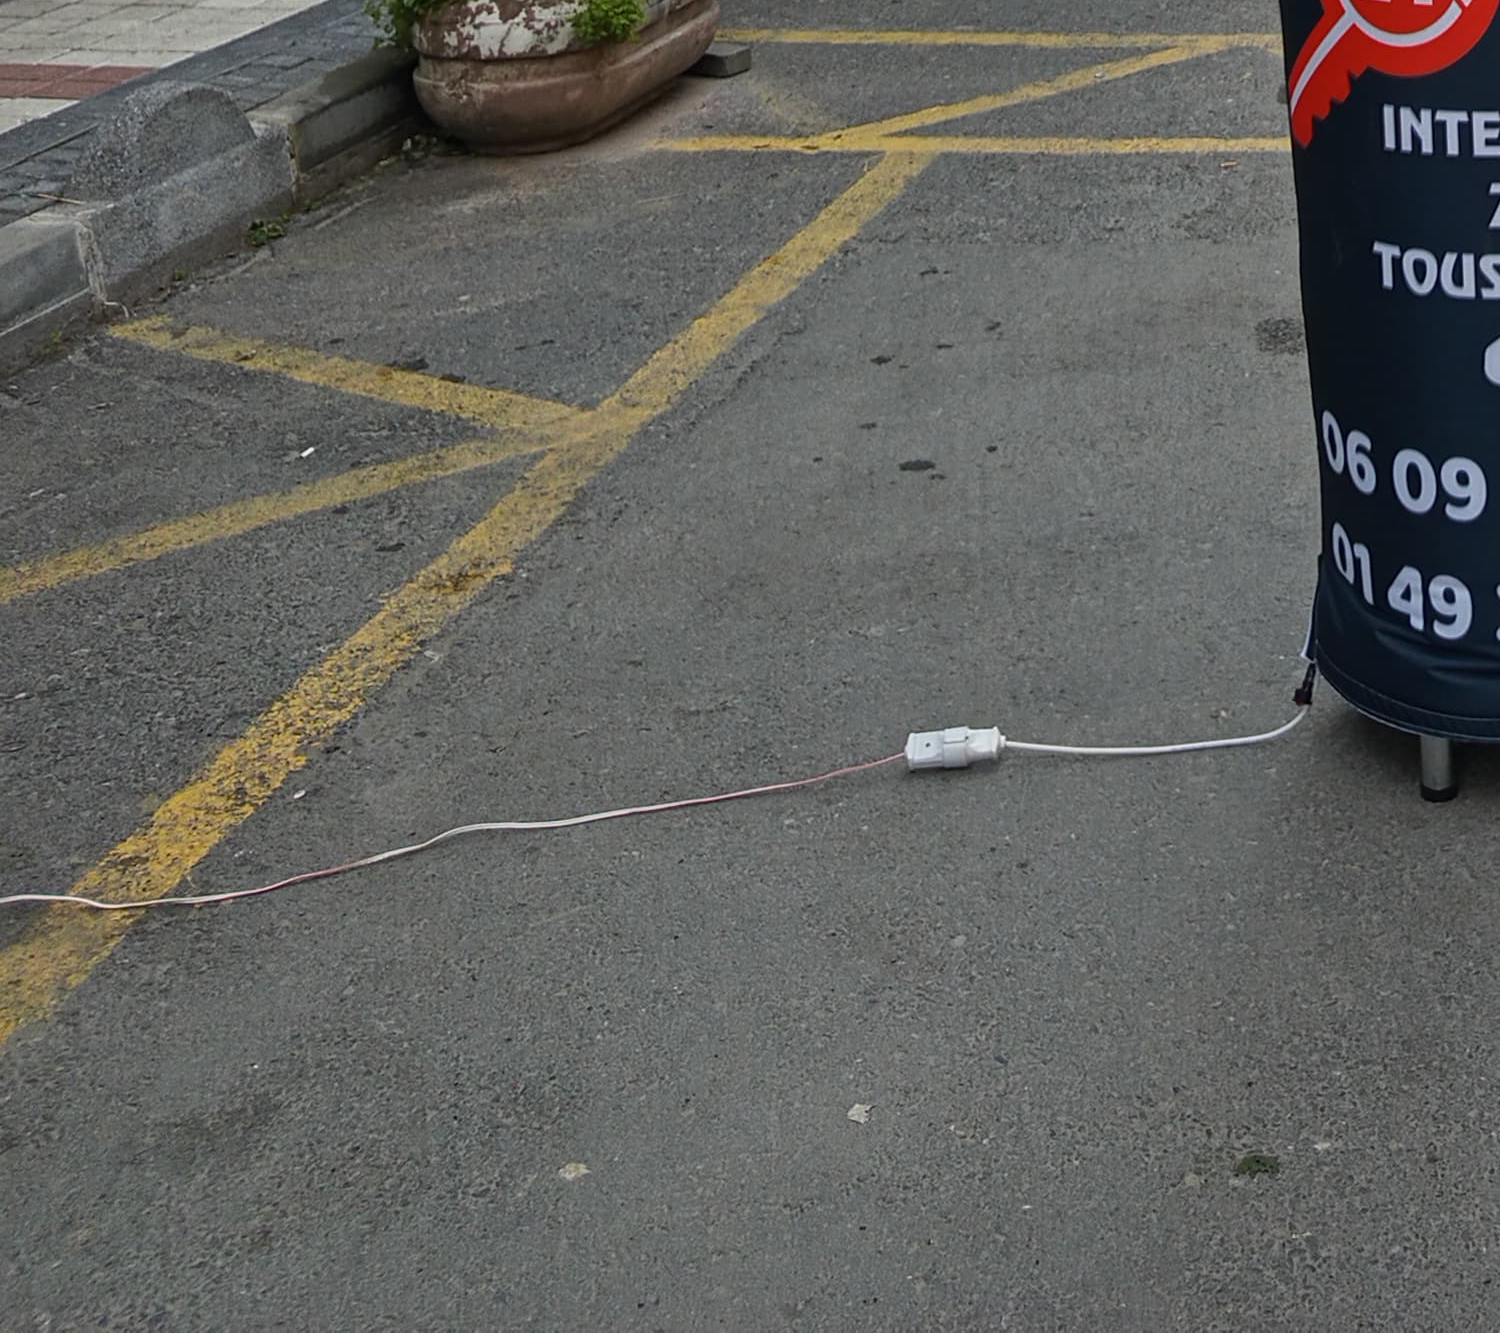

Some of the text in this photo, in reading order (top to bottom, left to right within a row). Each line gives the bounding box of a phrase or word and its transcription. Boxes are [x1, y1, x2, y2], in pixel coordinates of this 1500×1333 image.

[1322, 411, 1376, 493] 06
[1393, 449, 1487, 521] 09
[1332, 522, 1374, 605] 01
[1387, 566, 1473, 639] 49
